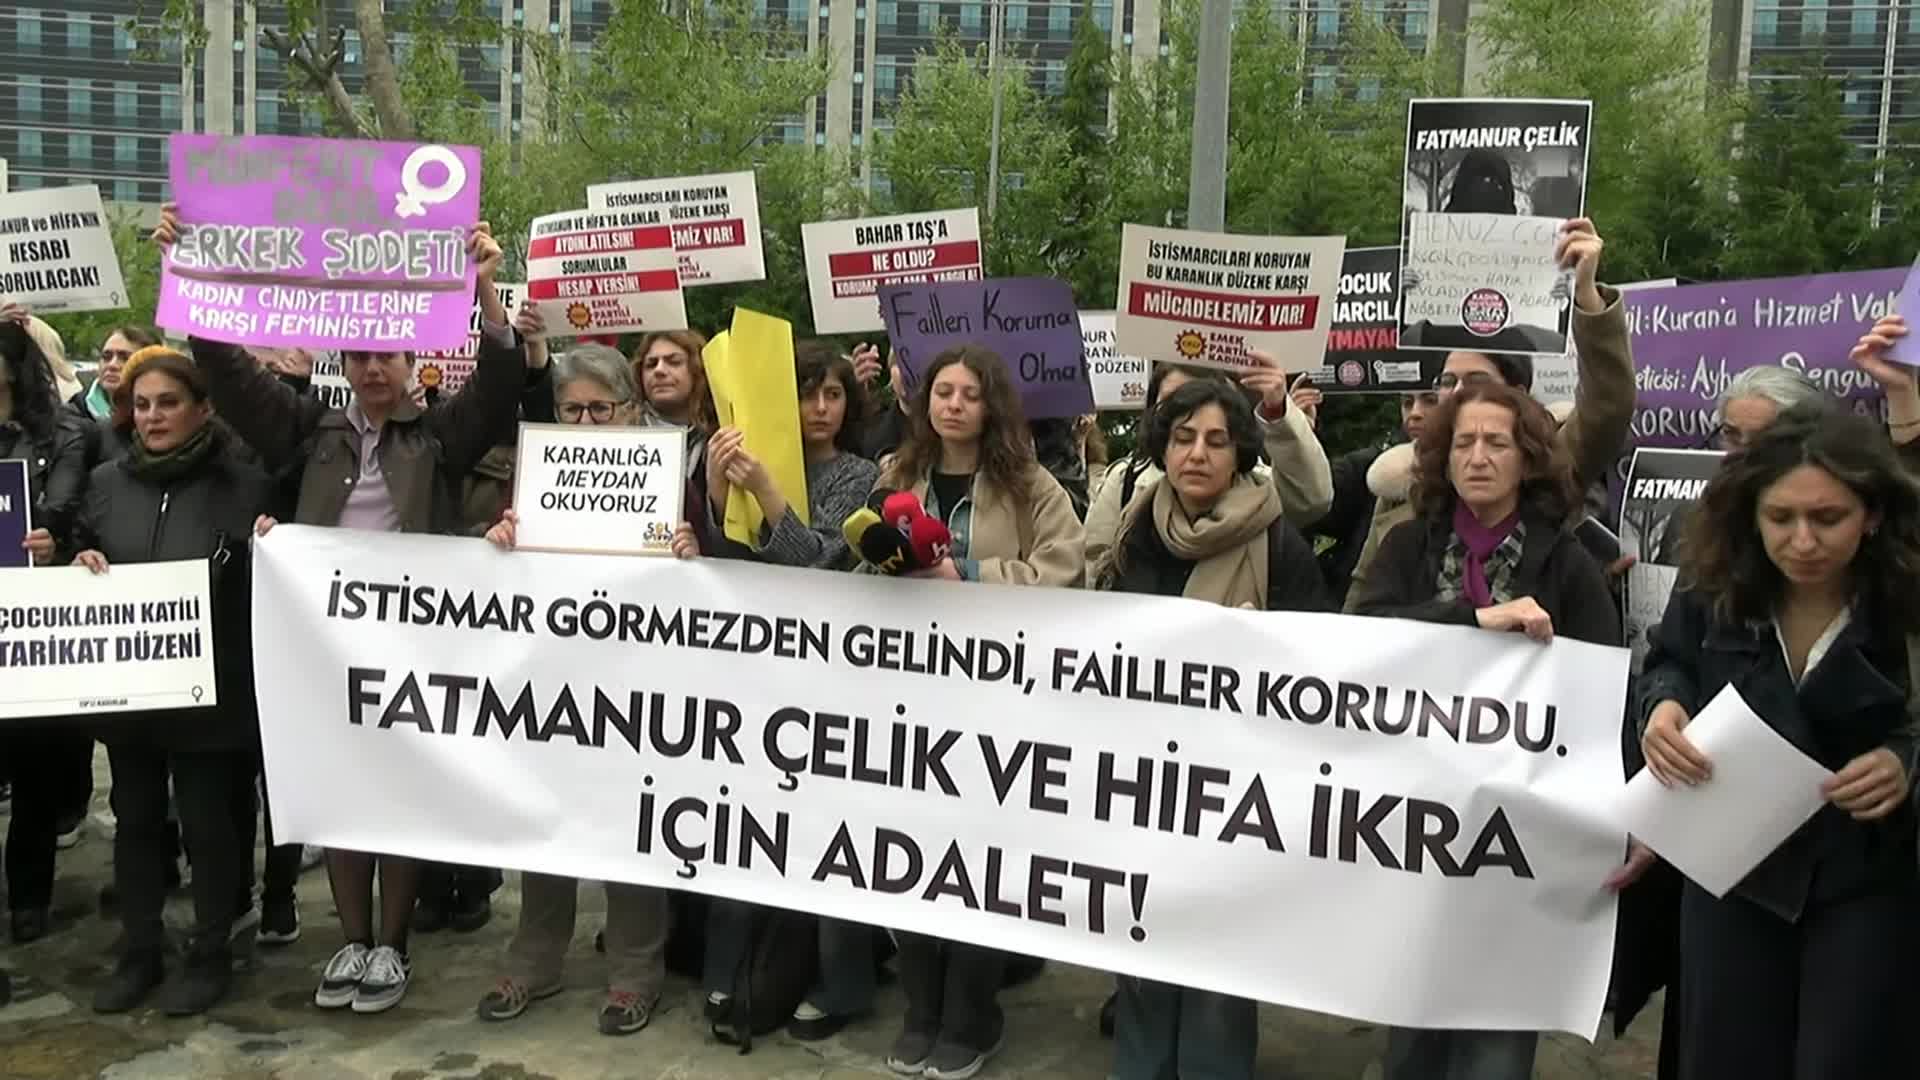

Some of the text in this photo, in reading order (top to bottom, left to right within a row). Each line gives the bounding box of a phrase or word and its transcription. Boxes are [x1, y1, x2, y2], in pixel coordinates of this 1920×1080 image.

[1416, 121, 1580, 152] FATMANUR ÇELİK
[606, 186, 728, 208] İSTİSMARCILARI KORUYAN
[703, 203, 730, 218] KARŞI
[620, 210, 660, 226] OLANLAR
[555, 231, 635, 253] AYDINLATILSIN!
[704, 225, 734, 244] VAR!
[856, 219, 948, 246] BAHAR TAŞ'A
[9, 239, 71, 264] HESABI
[170, 224, 305, 273] ERKEK
[872, 249, 936, 272] NE OLDU?
[1148, 239, 1312, 270] İSTİSMARCILARI KORUYAN
[562, 257, 627, 274] SORUMLULAR
[1146, 264, 1309, 294] BU KARANLIK DÜZENE KARŞI
[178, 278, 244, 307] KADIN
[557, 273, 639, 297] HESAP VERSİN!
[1338, 271, 1392, 295] OCUK
[189, 304, 258, 337] KARŞI
[983, 288, 1071, 332] Koruma
[1143, 291, 1305, 326] MÜCADELEMİZ VAR!
[1754, 291, 1844, 328] Hizmet
[1210, 332, 1245, 344] EMEK
[544, 444, 662, 467] KARANLIĞA
[556, 469, 647, 489] MEYDAN
[540, 492, 658, 514] OKUYORUZ
[141, 596, 200, 623] KATİLİ
[0, 627, 202, 668] TARİKAT DÜZENİ
[327, 569, 1569, 758] İSTİSMAR GÖRMEZDEN GELİNDİ, FAİLLER KORUNDU.
[347, 667, 1536, 880] FATMANUR ÇELİK VE HİFA İKRA
[636, 774, 1149, 943] İÇİN ADALET!
